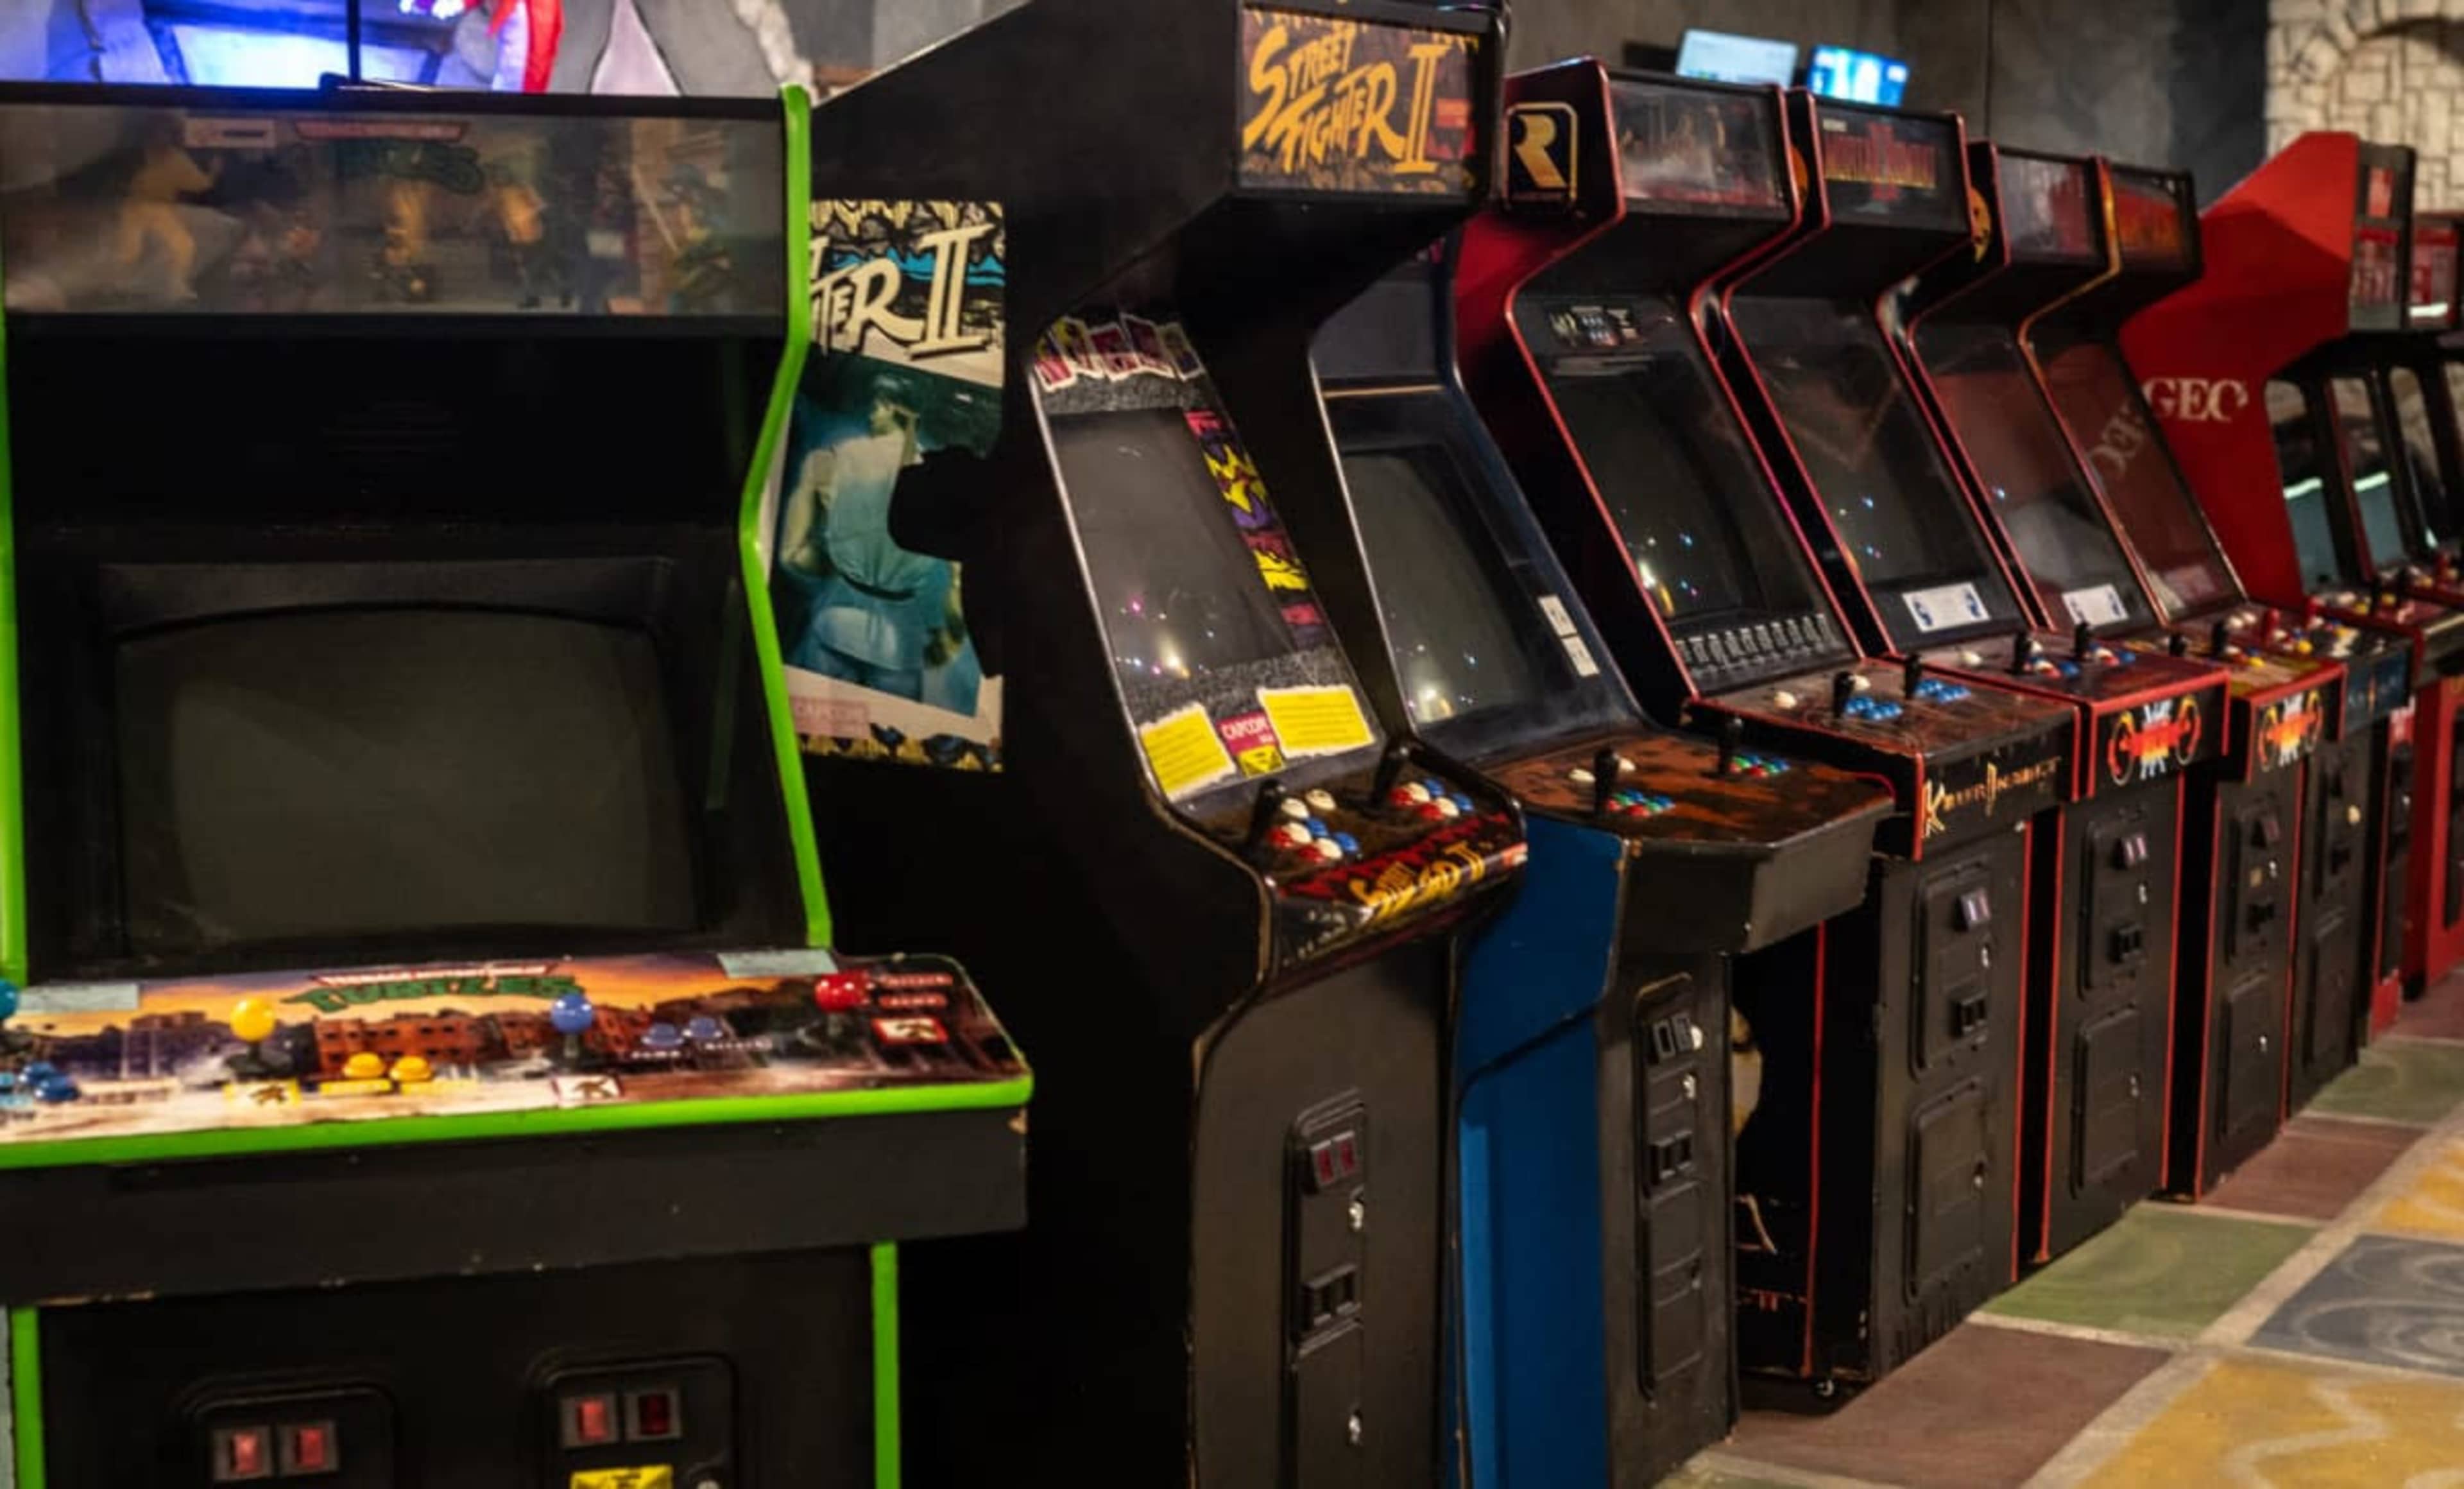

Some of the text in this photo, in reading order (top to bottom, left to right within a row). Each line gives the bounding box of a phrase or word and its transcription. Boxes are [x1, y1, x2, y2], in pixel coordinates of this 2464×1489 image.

[1243, 17, 1356, 150] STREET
[1265, 44, 1452, 174] FIGHTER II
[1514, 114, 1567, 187] R
[907, 223, 997, 352] II
